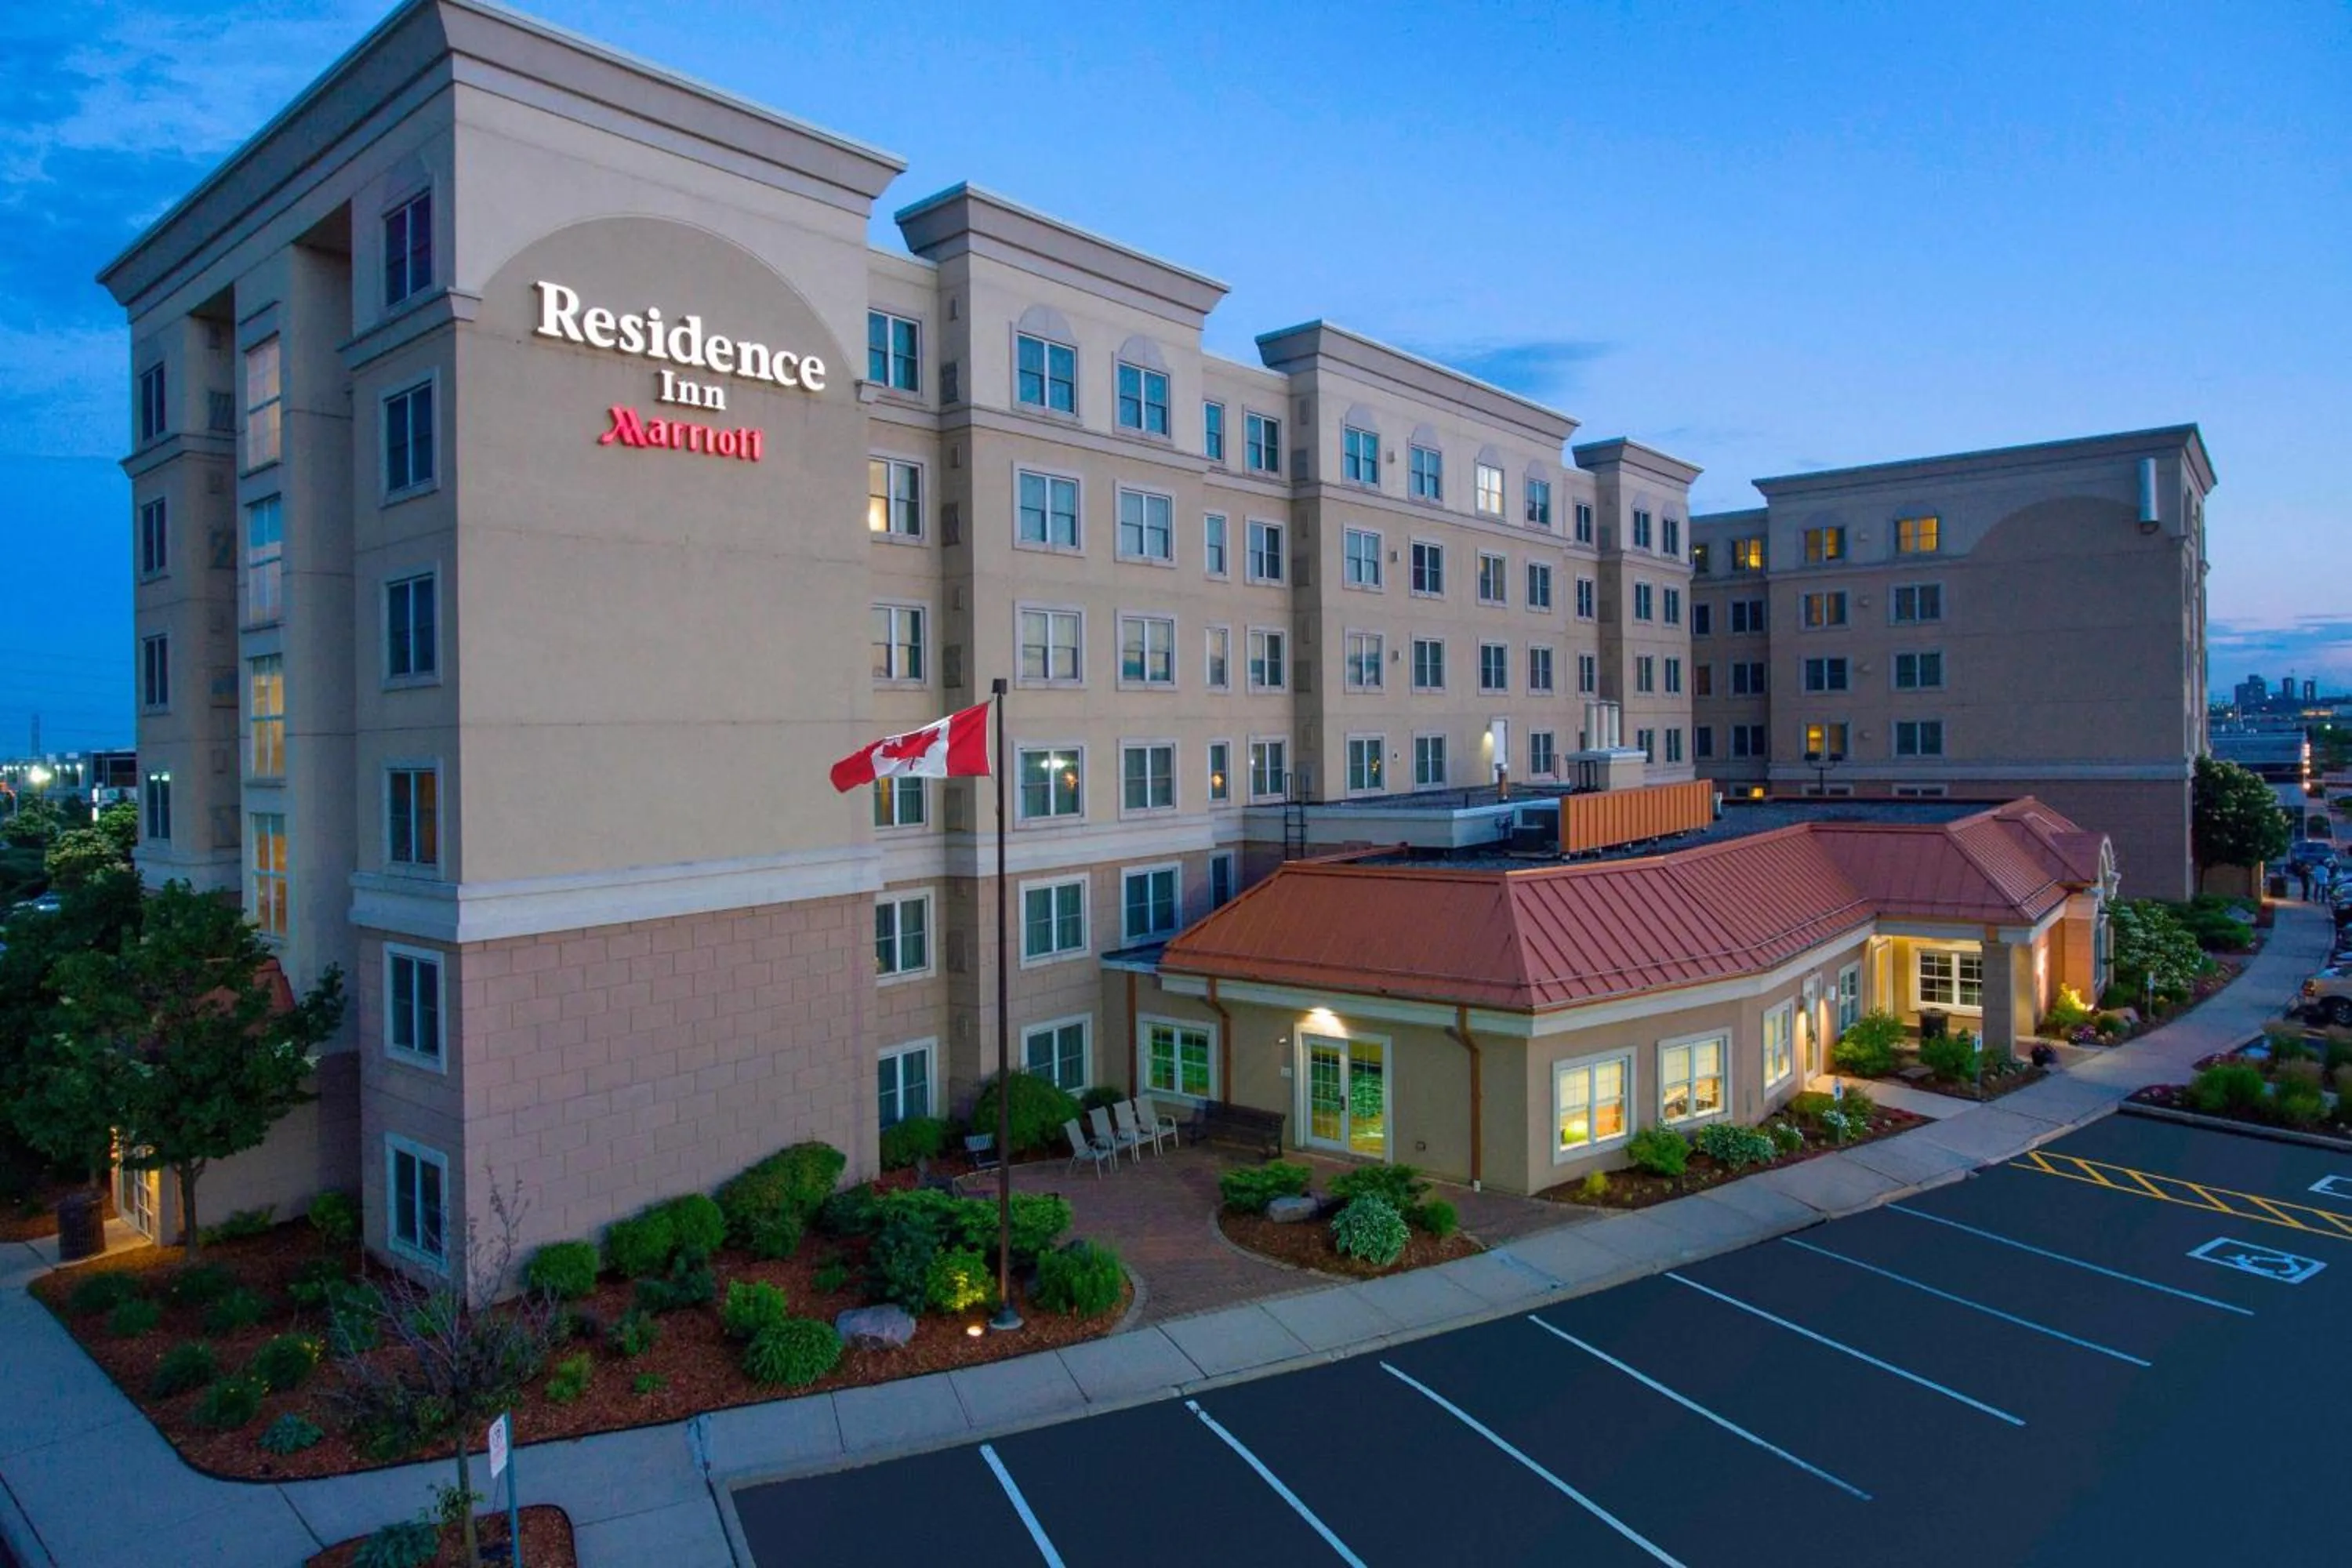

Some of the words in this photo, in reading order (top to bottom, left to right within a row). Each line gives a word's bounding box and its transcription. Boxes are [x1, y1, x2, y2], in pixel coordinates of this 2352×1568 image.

[536, 280, 826, 391] Residence
[659, 368, 726, 410] Inn
[600, 405, 764, 460] Marriott
